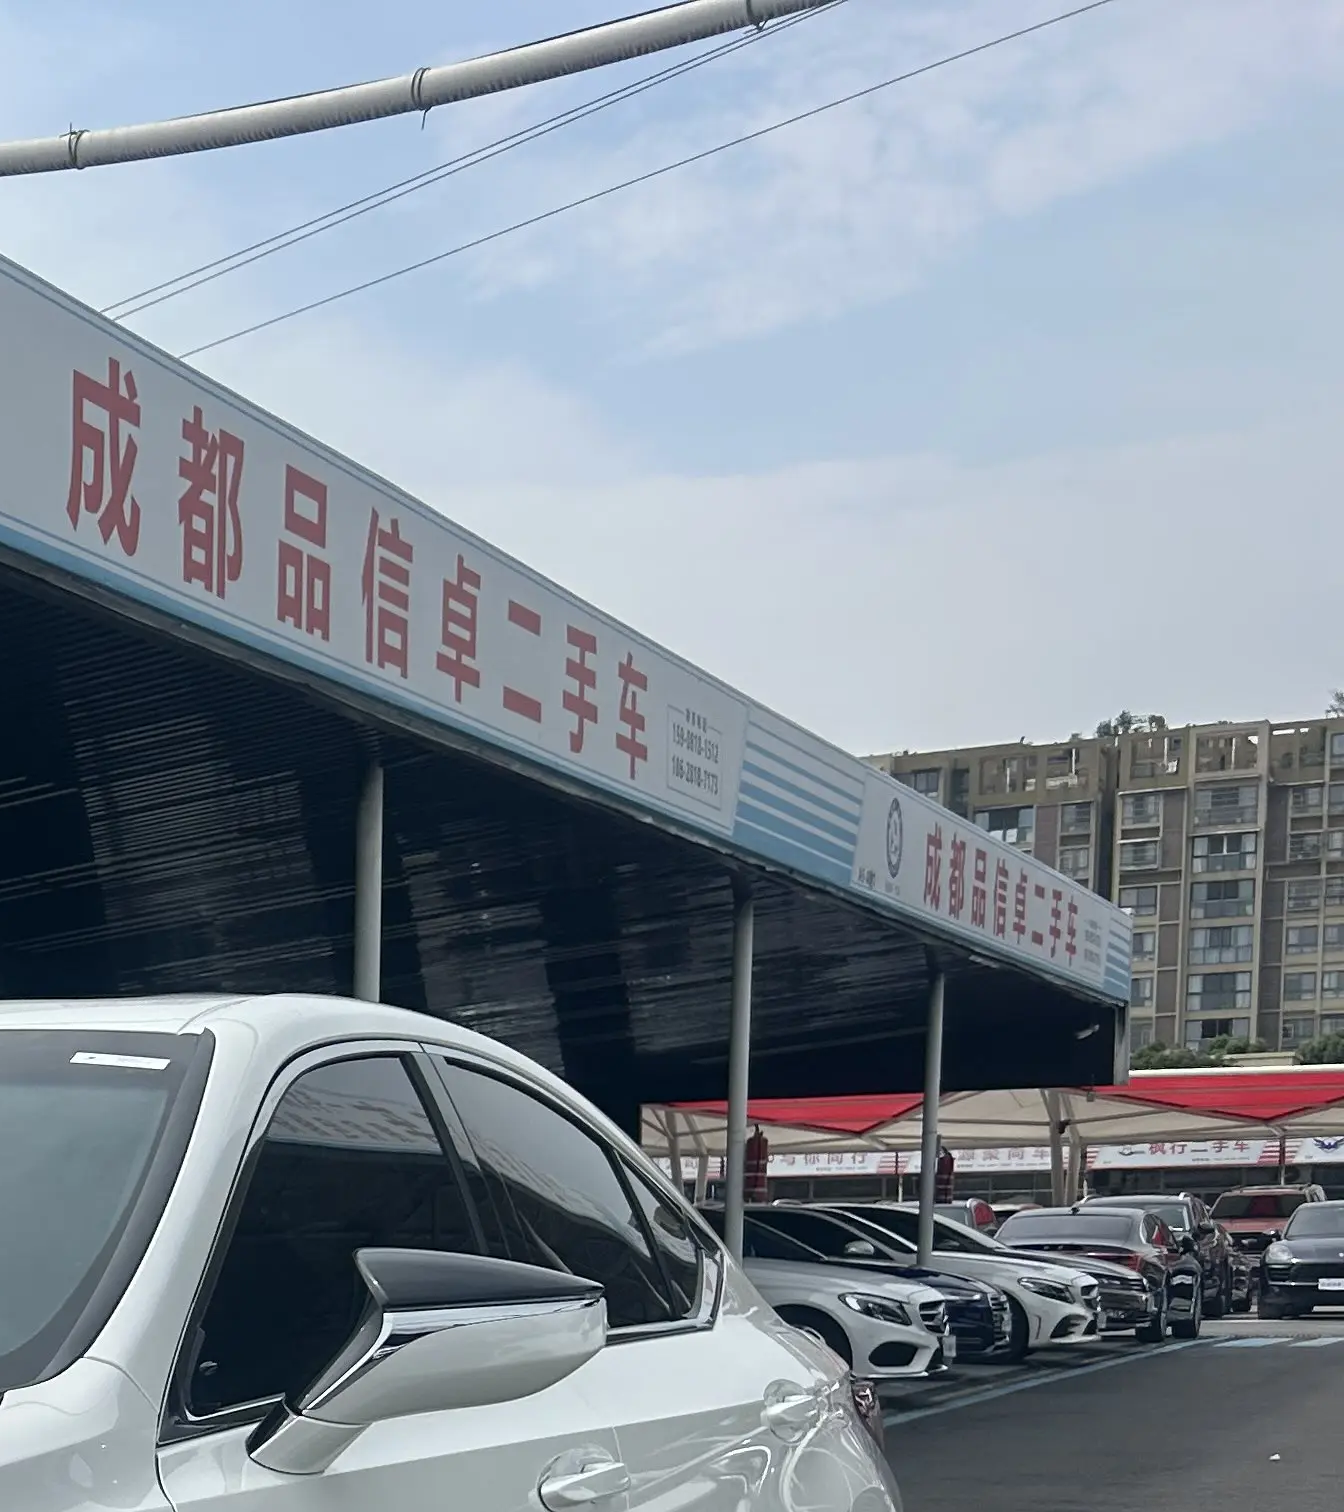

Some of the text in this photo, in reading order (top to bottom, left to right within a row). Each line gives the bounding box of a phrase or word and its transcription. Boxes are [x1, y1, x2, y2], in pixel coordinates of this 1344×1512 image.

[66, 357, 648, 780] 成都品信卓二手车
[924, 821, 1078, 967] 成都品信卓二手车
